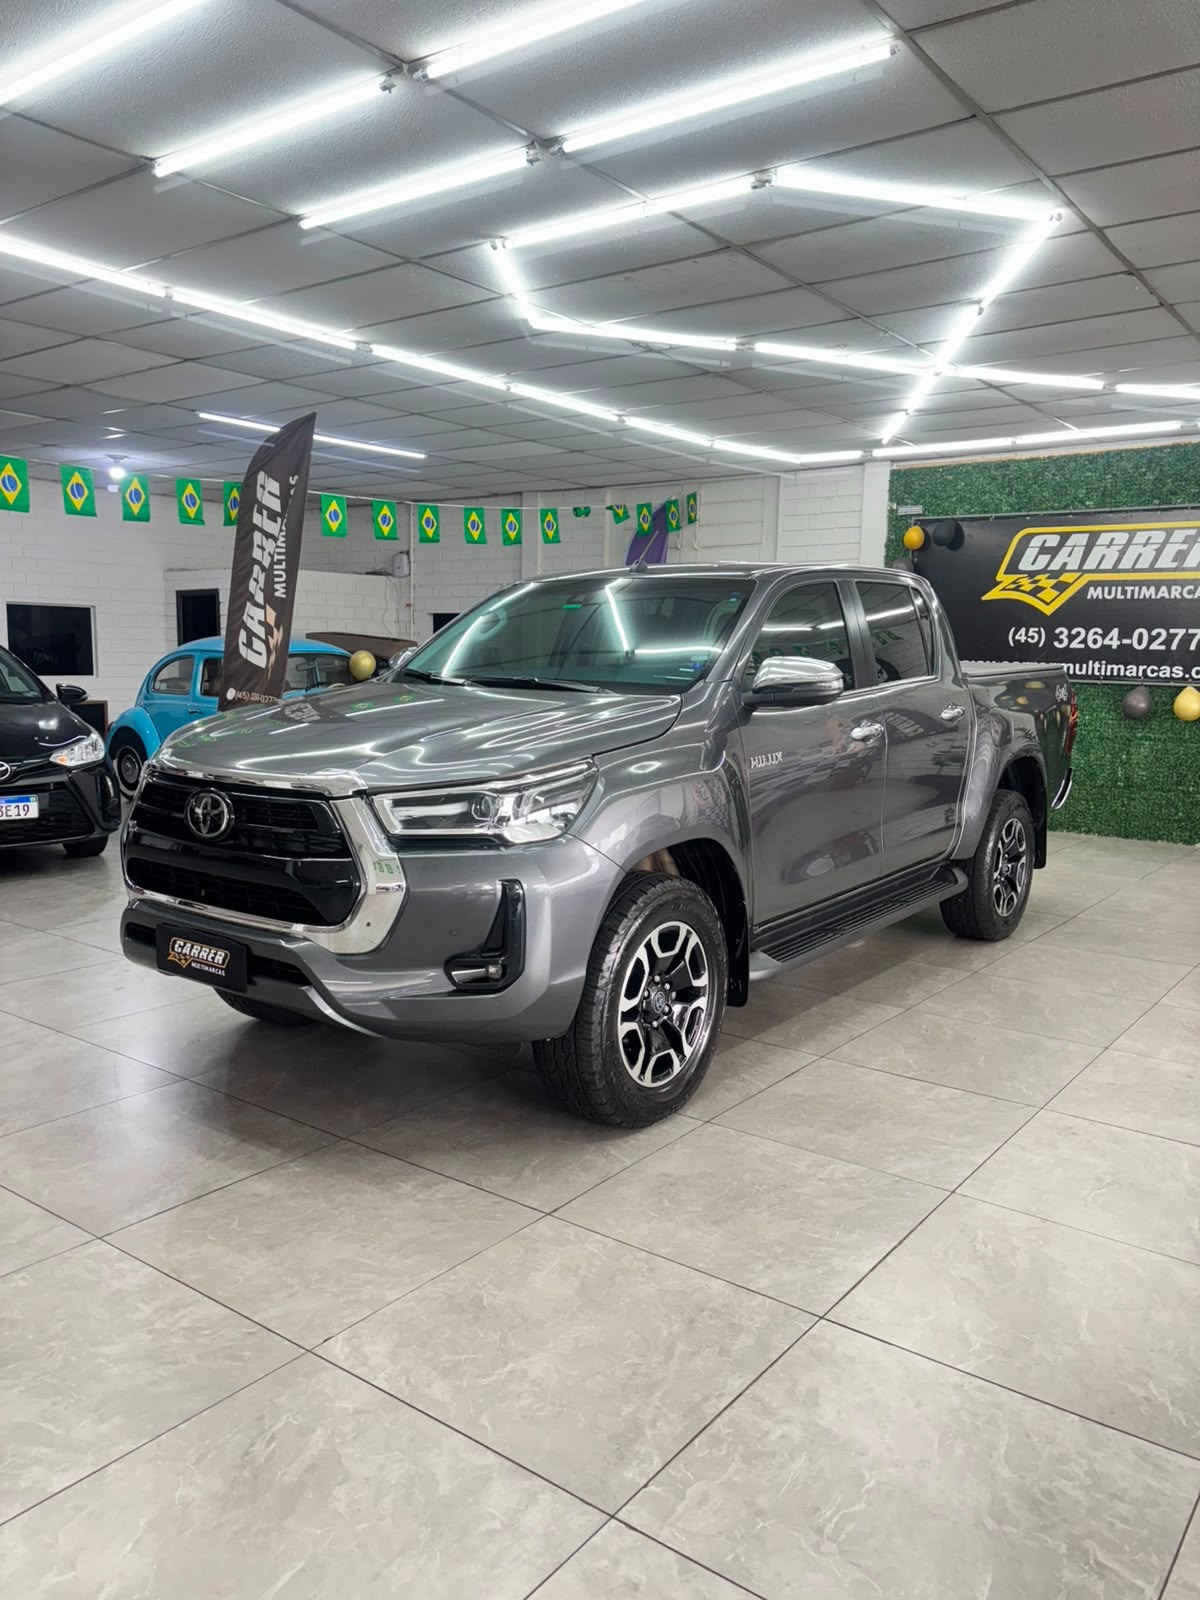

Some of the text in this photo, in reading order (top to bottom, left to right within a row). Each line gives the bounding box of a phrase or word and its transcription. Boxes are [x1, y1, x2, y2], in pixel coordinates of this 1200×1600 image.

[238, 470, 283, 670] CARRER
[1008, 626, 1200, 651] (45) 3264-0277
[173, 940, 225, 965] CARRER
